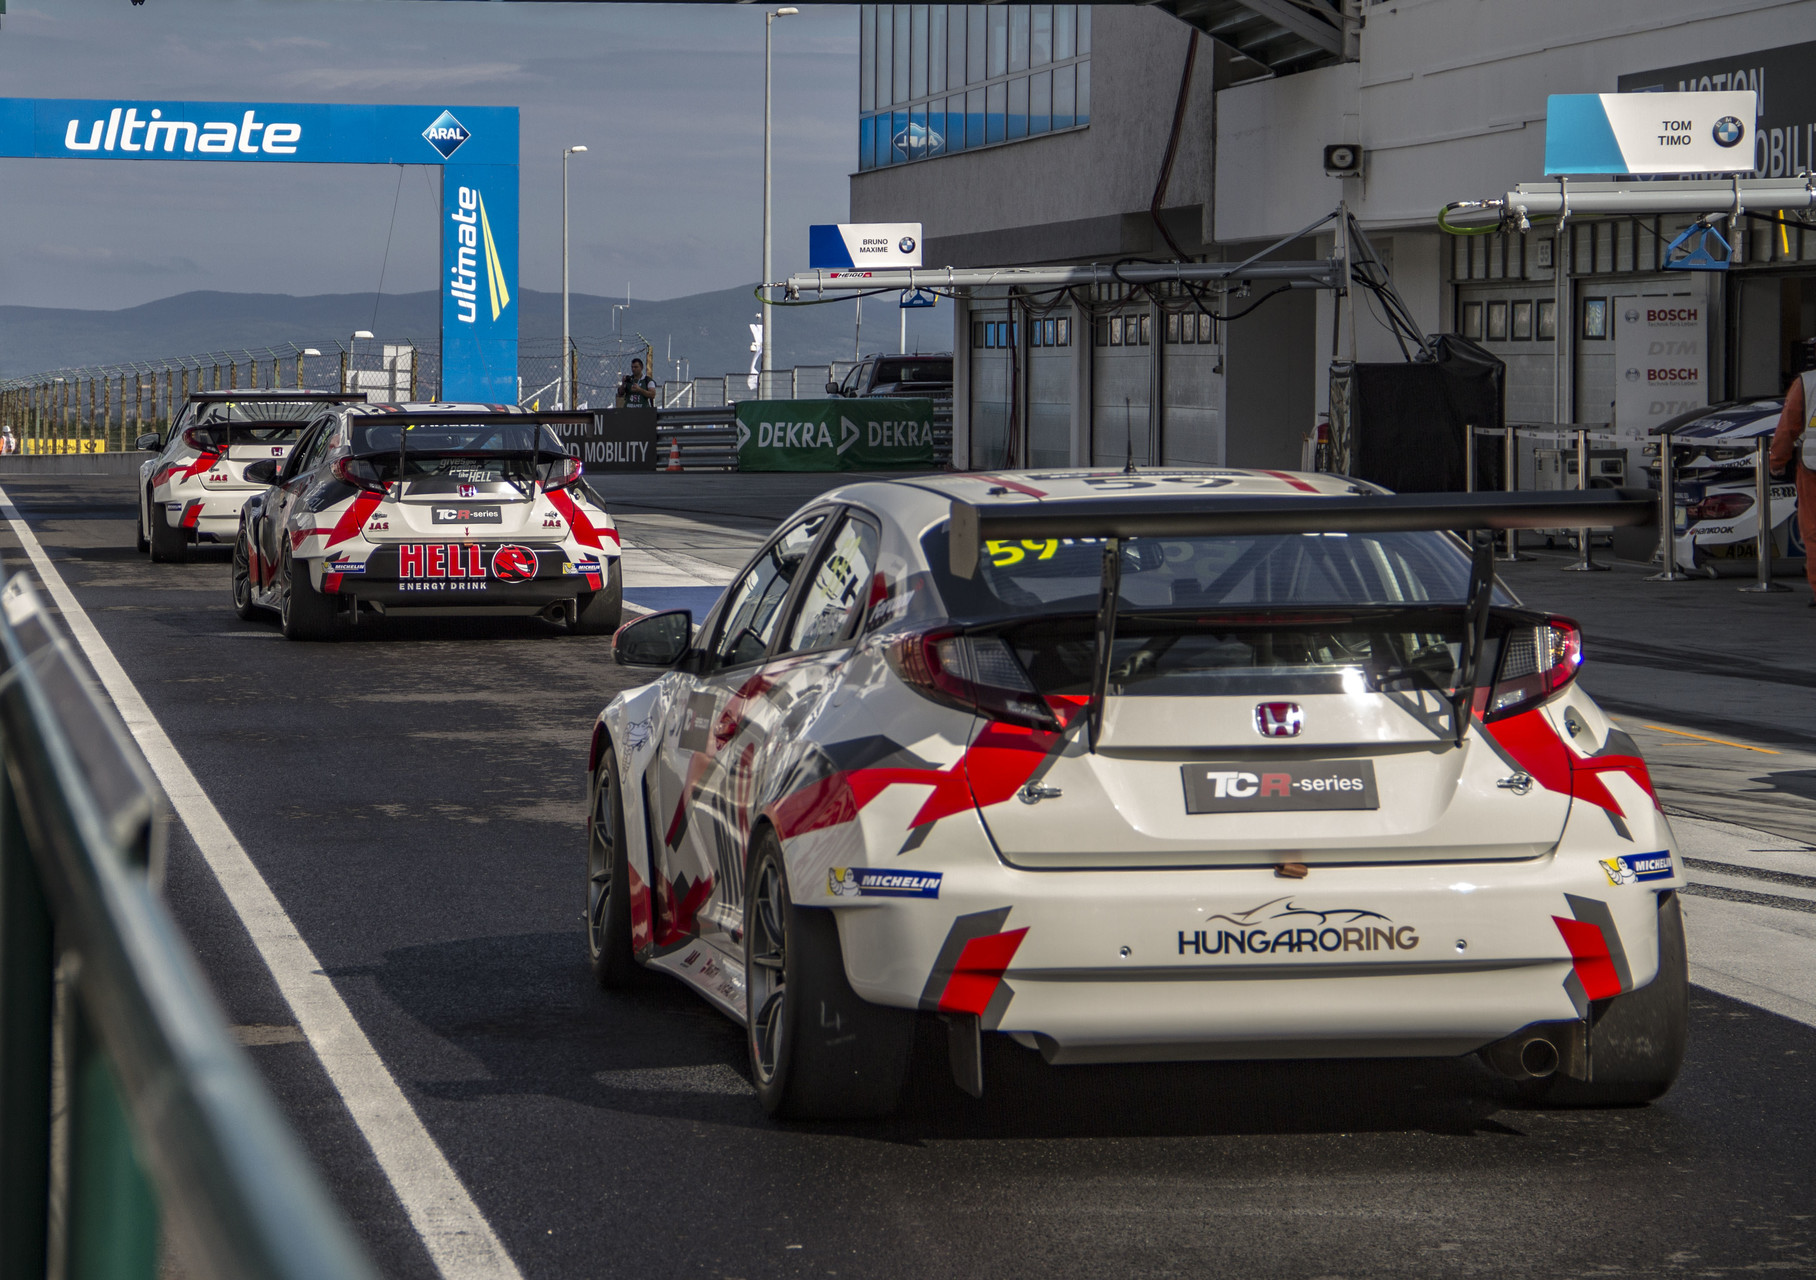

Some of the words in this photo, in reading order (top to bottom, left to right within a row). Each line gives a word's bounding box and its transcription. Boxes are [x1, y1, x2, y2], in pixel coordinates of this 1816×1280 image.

[64, 107, 302, 154] ultimate
[1662, 120, 1692, 131] TOM
[429, 127, 464, 140] ARAL
[1658, 135, 1692, 146] TIMO
[451, 186, 477, 323] ultimate
[1647, 308, 1698, 322] BOSCH
[1648, 340, 1698, 356] DTM
[1647, 368, 1698, 381] BOSCH
[758, 421, 834, 448] DEKRA
[868, 420, 933, 447] DEKRA
[584, 441, 649, 463] MOBILITY
[439, 458, 466, 469] gives
[209, 474, 228, 482] JAS
[468, 471, 492, 483] HELL
[436, 508, 499, 520] TCR-series
[368, 522, 389, 530] JAS
[542, 519, 562, 527] JAS
[985, 538, 1059, 568] 59
[399, 544, 487, 578] HELL
[399, 582, 446, 591] ENERGY
[450, 582, 487, 590] DRINK
[1206, 770, 1364, 799] TCR-series
[861, 872, 941, 891] MICHELIN
[1178, 925, 1420, 955] HUNGARORING
